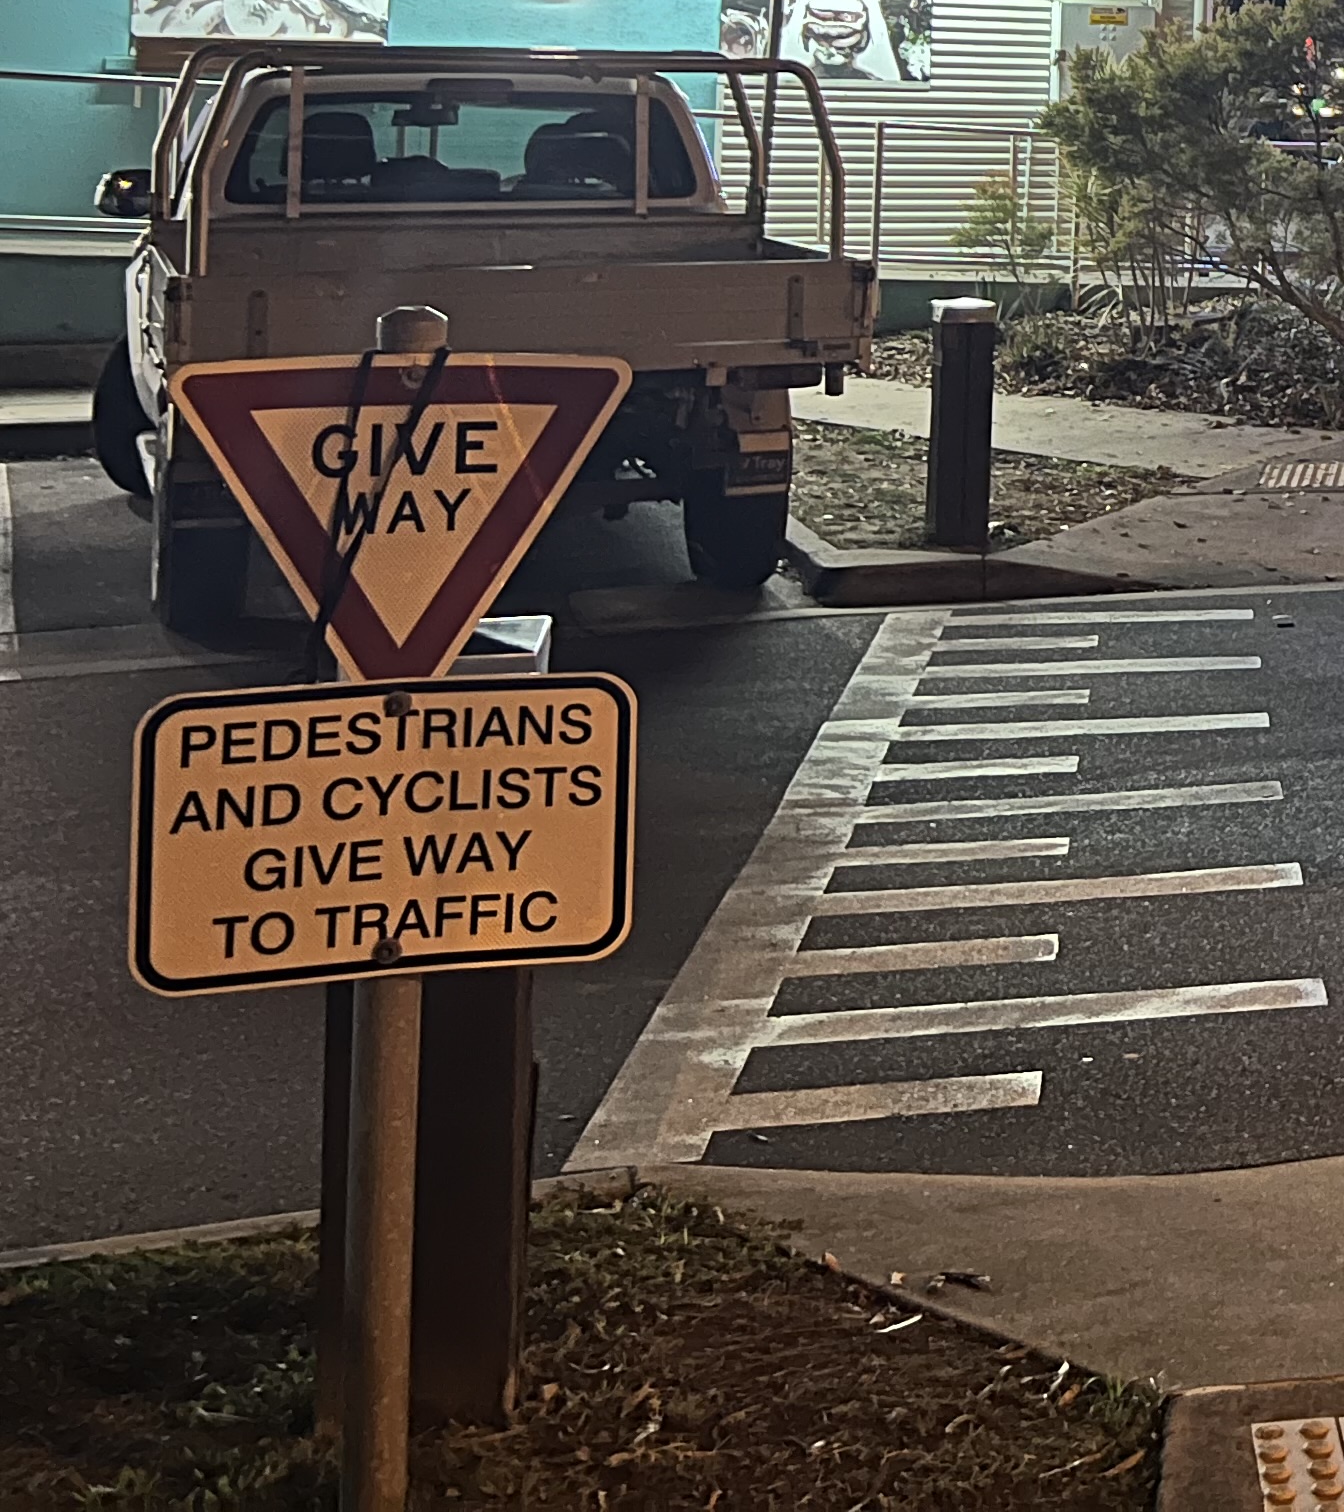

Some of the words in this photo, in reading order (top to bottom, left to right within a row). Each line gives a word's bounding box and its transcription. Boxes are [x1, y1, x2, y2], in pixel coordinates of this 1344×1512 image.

[312, 421, 499, 478] GIVE
[338, 488, 472, 535] WAY
[179, 703, 593, 769] PEDESTRIANS
[168, 783, 301, 835] AND
[322, 764, 602, 821] CYCLISTS
[243, 838, 384, 892] GIVE
[402, 829, 533, 877] WAY
[211, 911, 295, 959] TO
[314, 890, 558, 950] TRAFFIC
